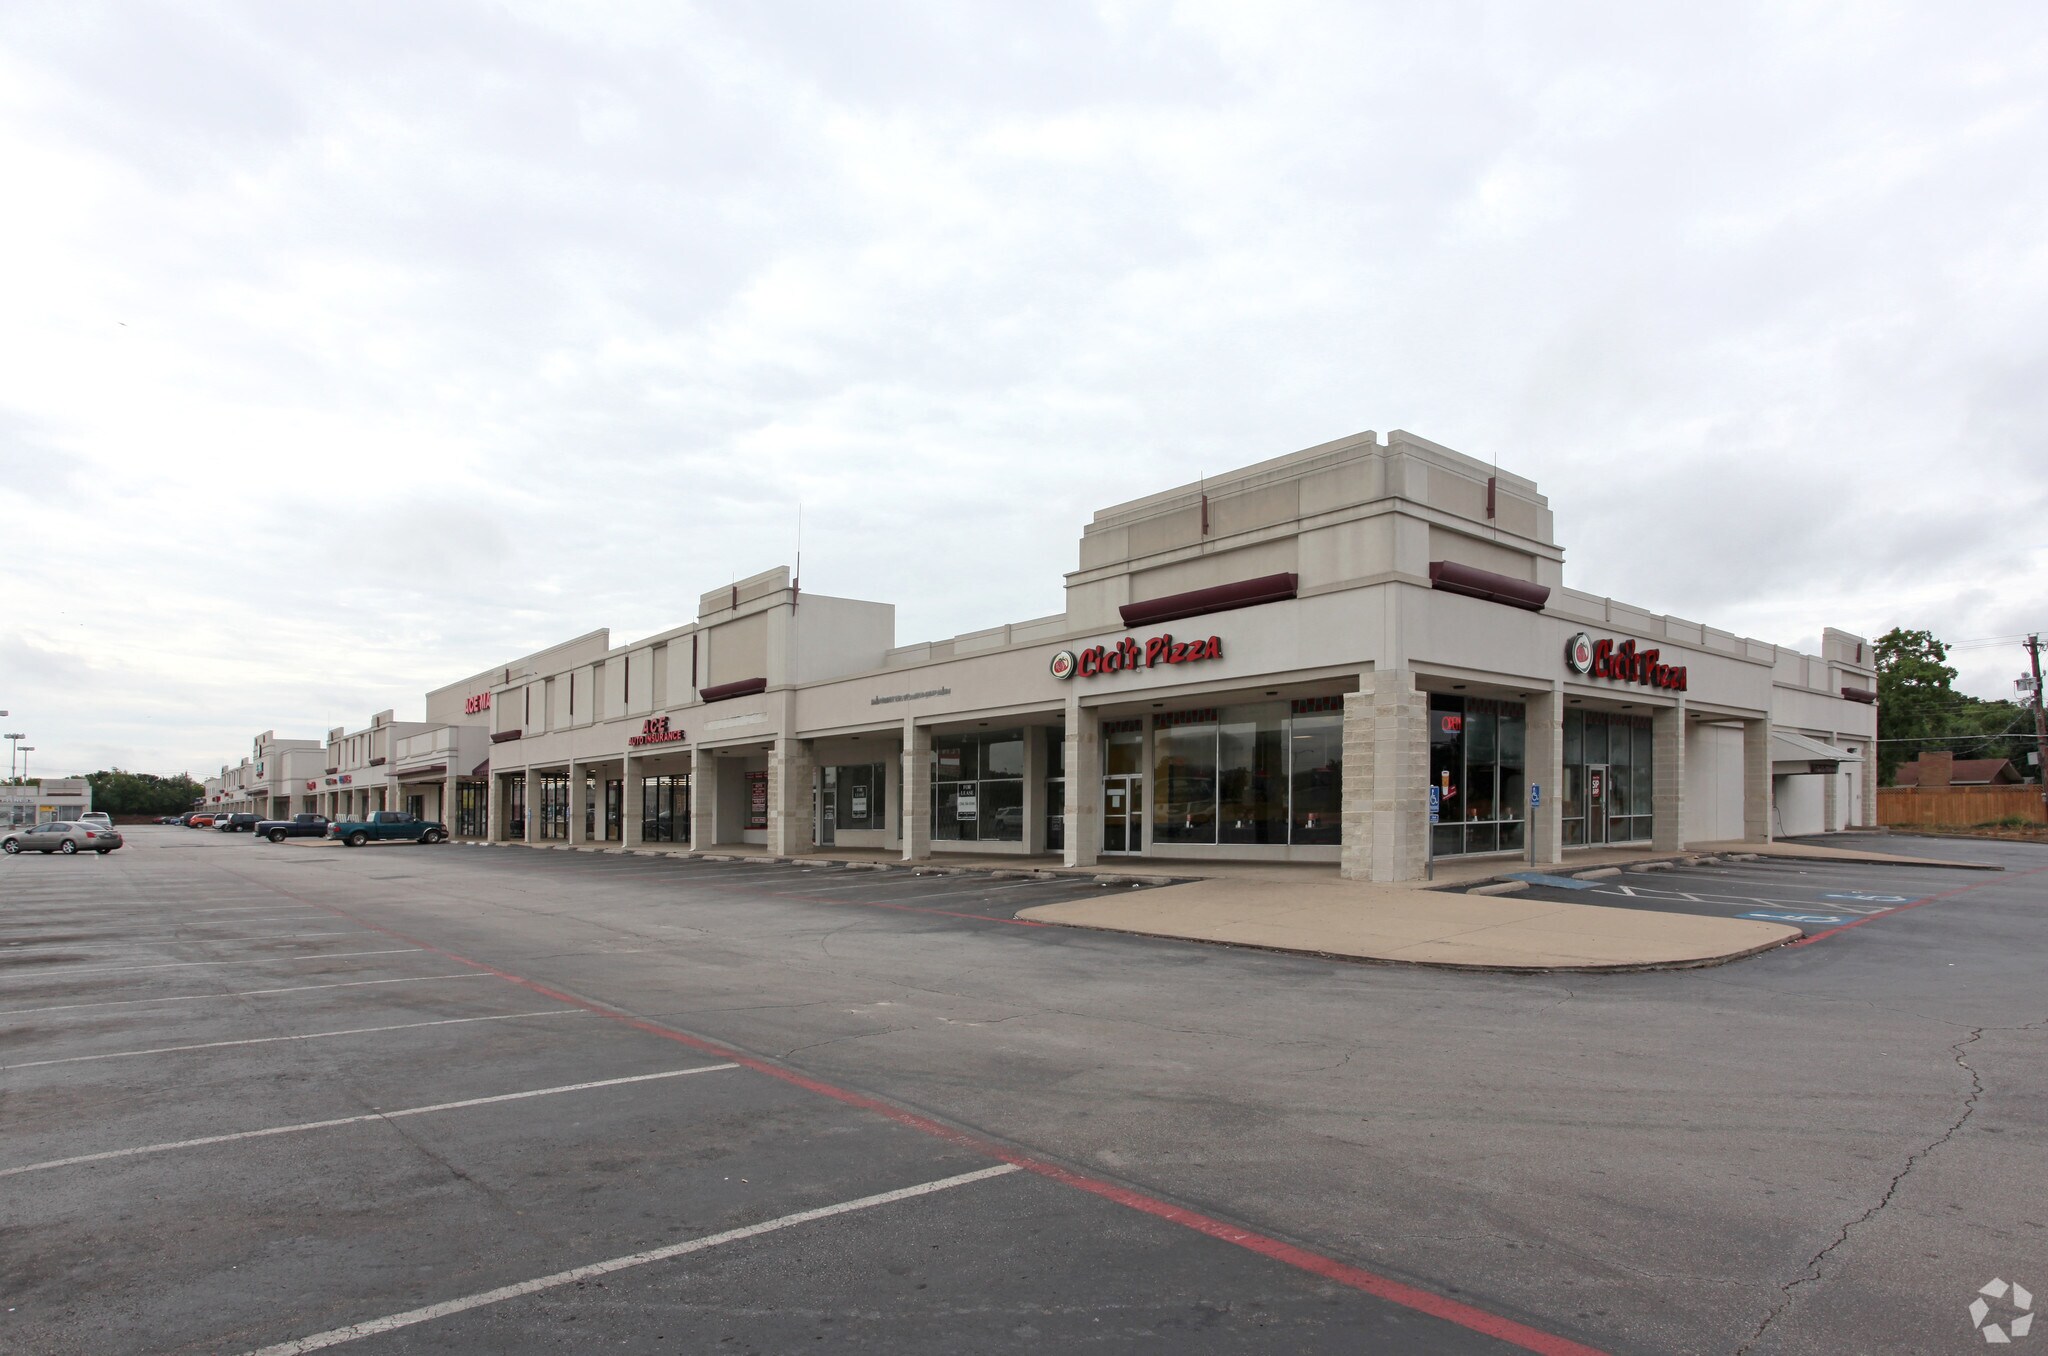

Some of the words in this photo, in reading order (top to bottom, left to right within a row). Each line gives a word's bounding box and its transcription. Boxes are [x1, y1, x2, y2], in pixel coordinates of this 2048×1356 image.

[1077, 636, 1140, 677] Cici's
[1145, 633, 1222, 668] Pizza
[464, 695, 481, 714] ACE
[642, 716, 669, 734] ACE
[1441, 716, 1461, 731] OPEN
[628, 735, 646, 746] AUTO
[646, 730, 685, 744] INSURANCE
